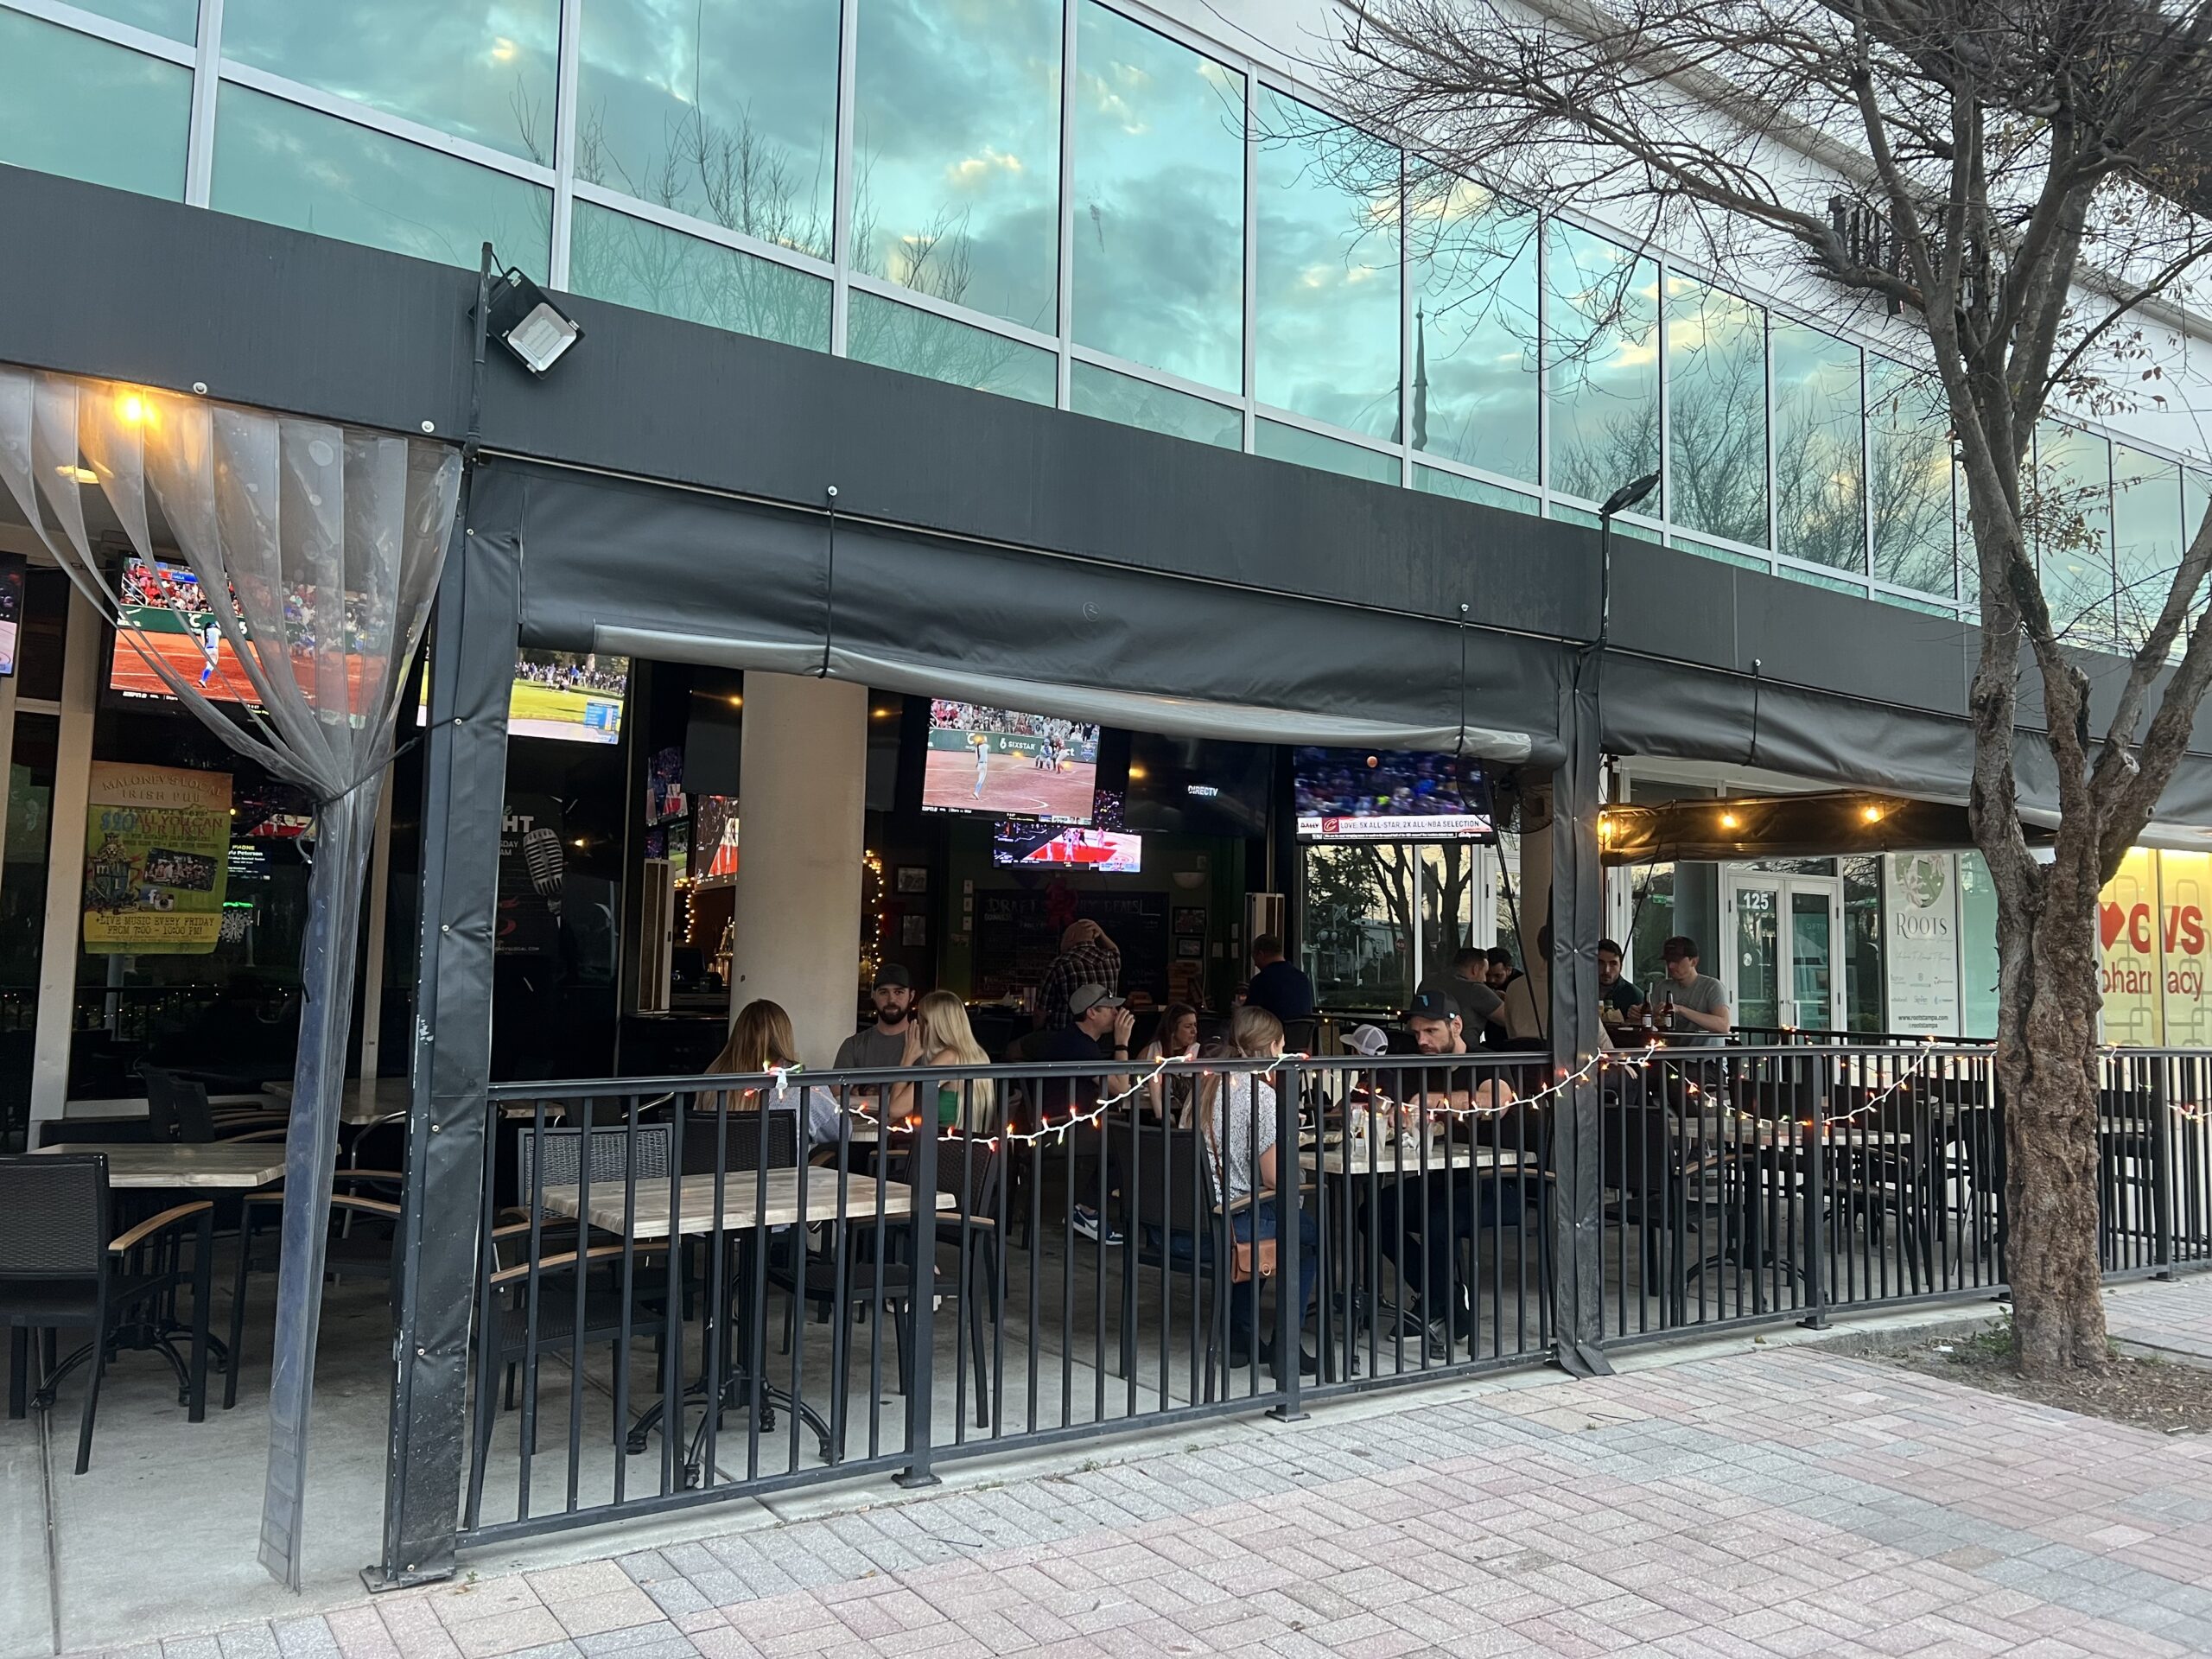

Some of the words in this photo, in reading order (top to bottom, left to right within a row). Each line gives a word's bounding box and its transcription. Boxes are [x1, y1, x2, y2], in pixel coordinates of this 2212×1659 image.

[1007, 741, 1036, 750] SIXSTAR
[102, 773, 179, 791] MALONEY'S
[181, 778, 222, 796] LOCAL
[1187, 785, 1219, 796] DIRECTV
[123, 790, 164, 801] IRISH
[173, 792, 200, 803] PUB
[137, 813, 158, 824] ALL
[161, 815, 189, 826] YOU
[192, 817, 223, 829] CAN
[1743, 892, 1770, 910] 125
[124, 916, 151, 926] MUSIC
[154, 917, 178, 926] EVERY
[184, 917, 214, 927] FRIDAY
[107, 925, 130, 935] FROM
[134, 926, 152, 935] 7:00
[162, 926, 186, 935] 10:00
[2129, 903, 2205, 955] CVS
[2101, 962, 2203, 1001] pharacy
